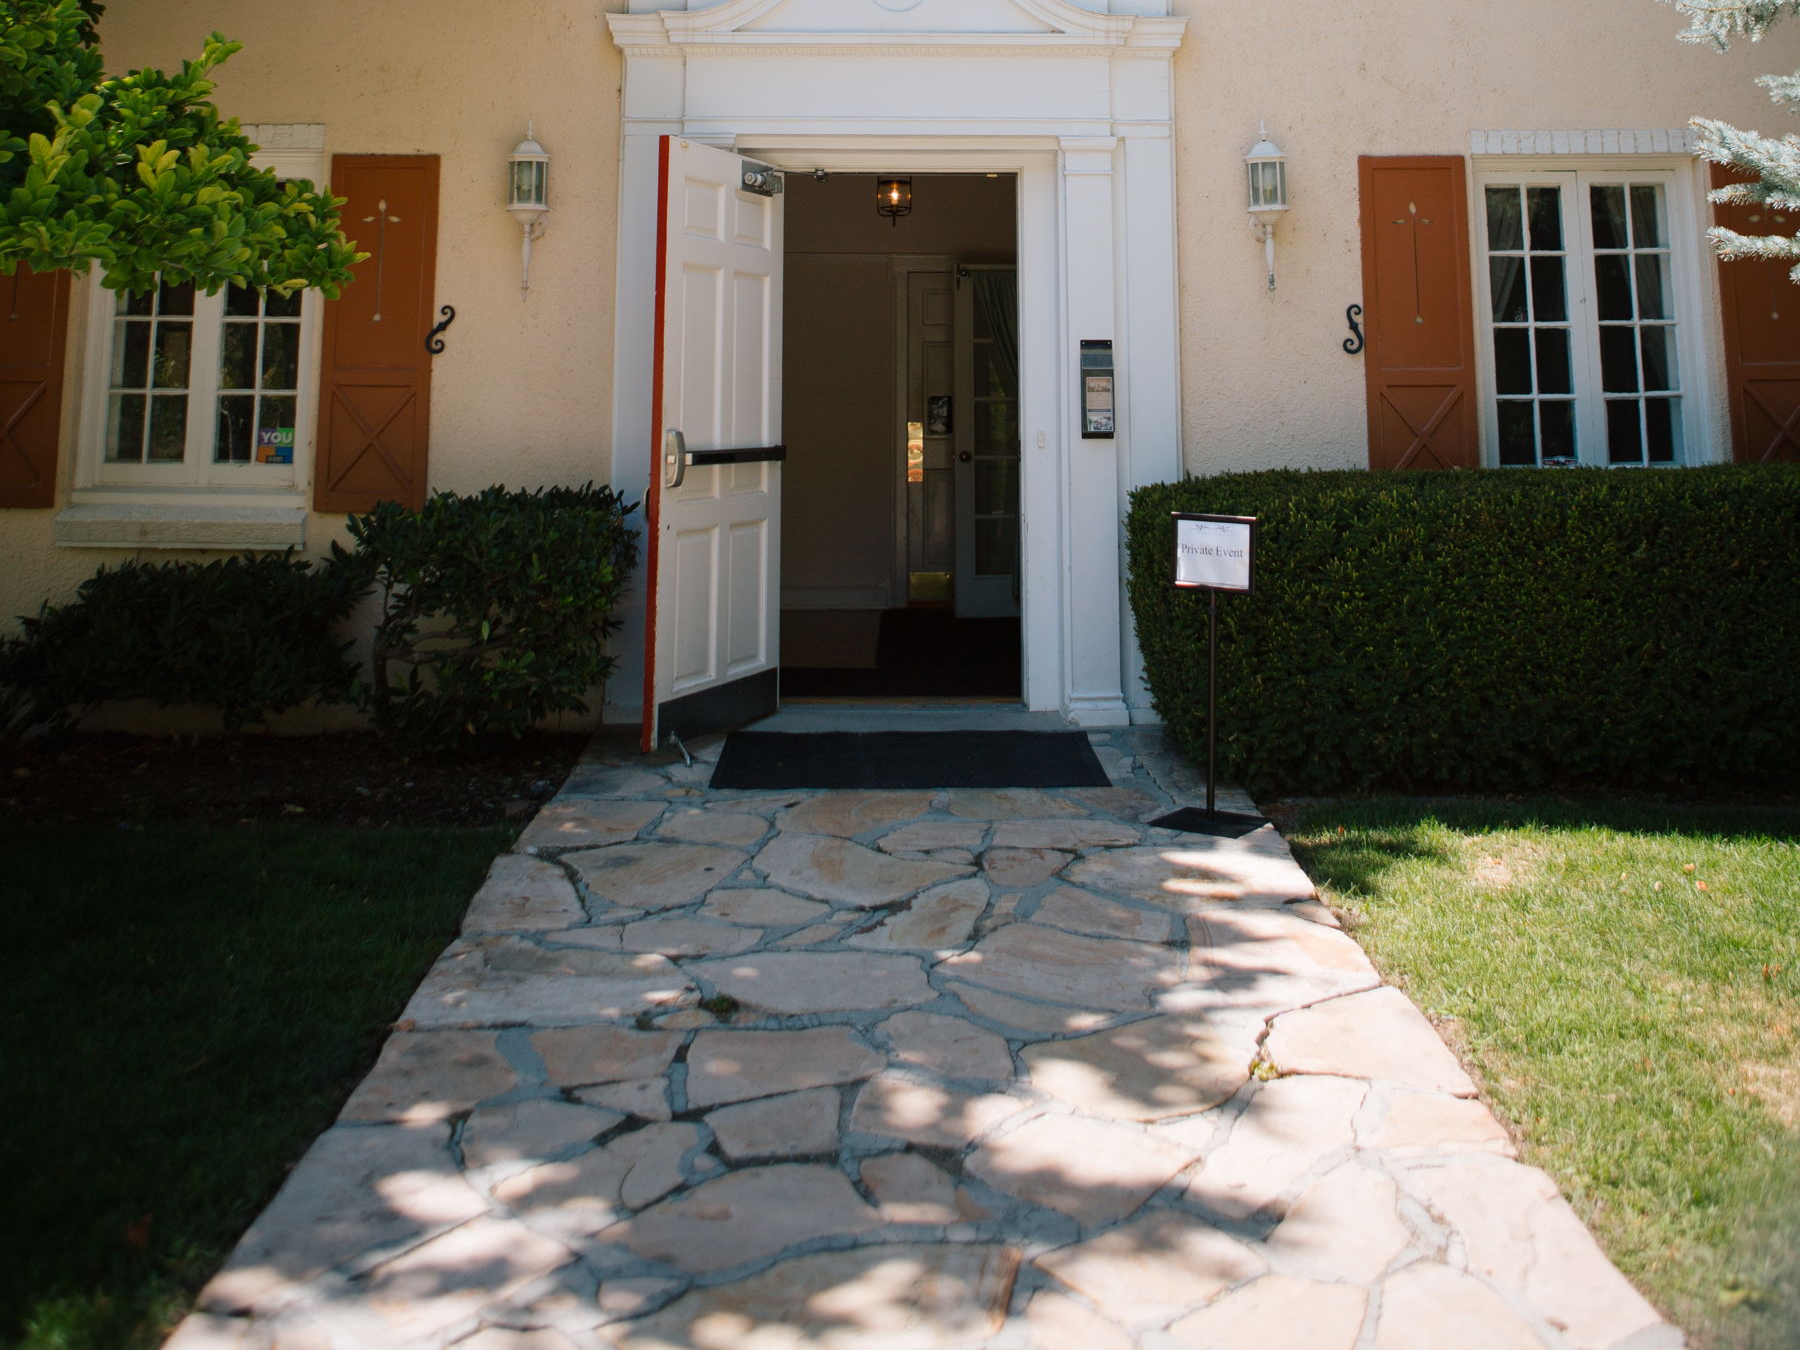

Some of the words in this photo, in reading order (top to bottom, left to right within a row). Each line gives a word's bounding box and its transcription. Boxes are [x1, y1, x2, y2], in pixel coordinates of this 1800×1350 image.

[261, 432, 293, 443] YOU
[1181, 543, 1213, 555] Private
[1216, 546, 1243, 558] Event
